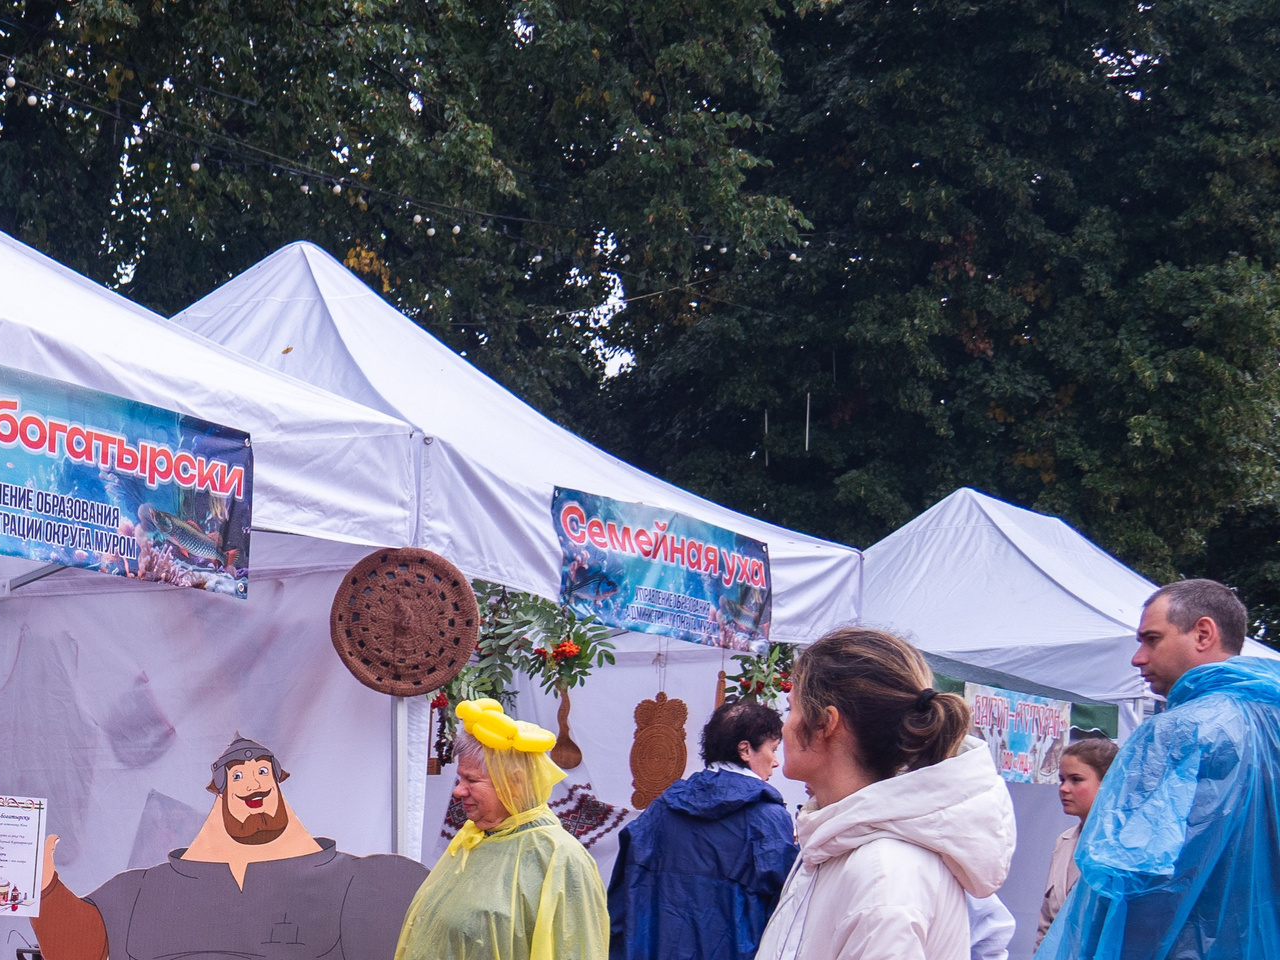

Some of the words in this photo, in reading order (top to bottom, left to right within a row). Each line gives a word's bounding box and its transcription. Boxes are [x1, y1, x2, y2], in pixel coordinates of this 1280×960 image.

[36, 491, 120, 528] ОБРАЗОВАНИЯ
[45, 520, 92, 551] ОКРУГА
[94, 530, 136, 559] МУРОМ
[561, 505, 719, 575] Семейная
[722, 550, 767, 588] уха
